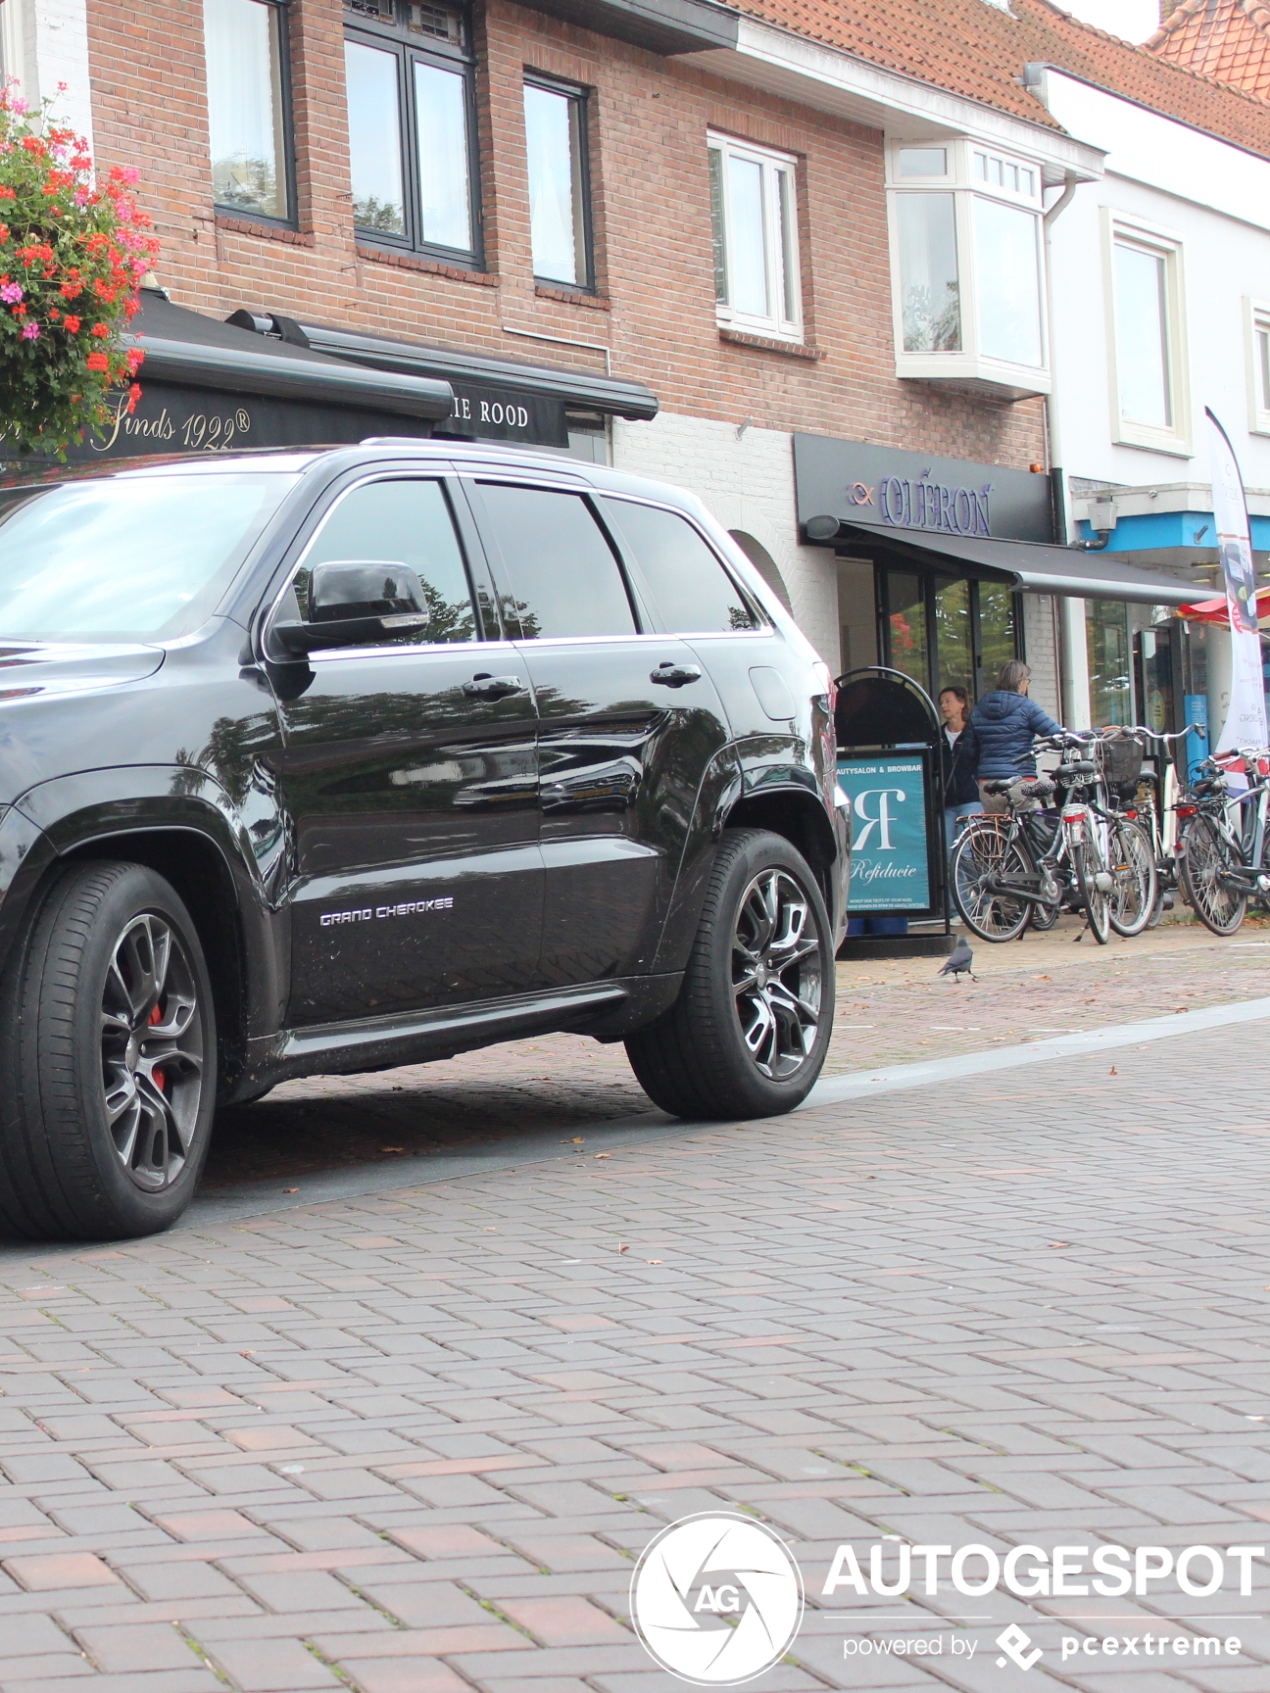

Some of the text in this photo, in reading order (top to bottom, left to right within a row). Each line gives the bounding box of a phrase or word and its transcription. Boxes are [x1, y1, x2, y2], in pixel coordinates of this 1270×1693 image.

[450, 396, 528, 427] IE ROOD
[882, 467, 995, 537] OLÉRON
[836, 766, 876, 776] AUTYSALON
[320, 897, 454, 926] GRAND CHEROKEE
